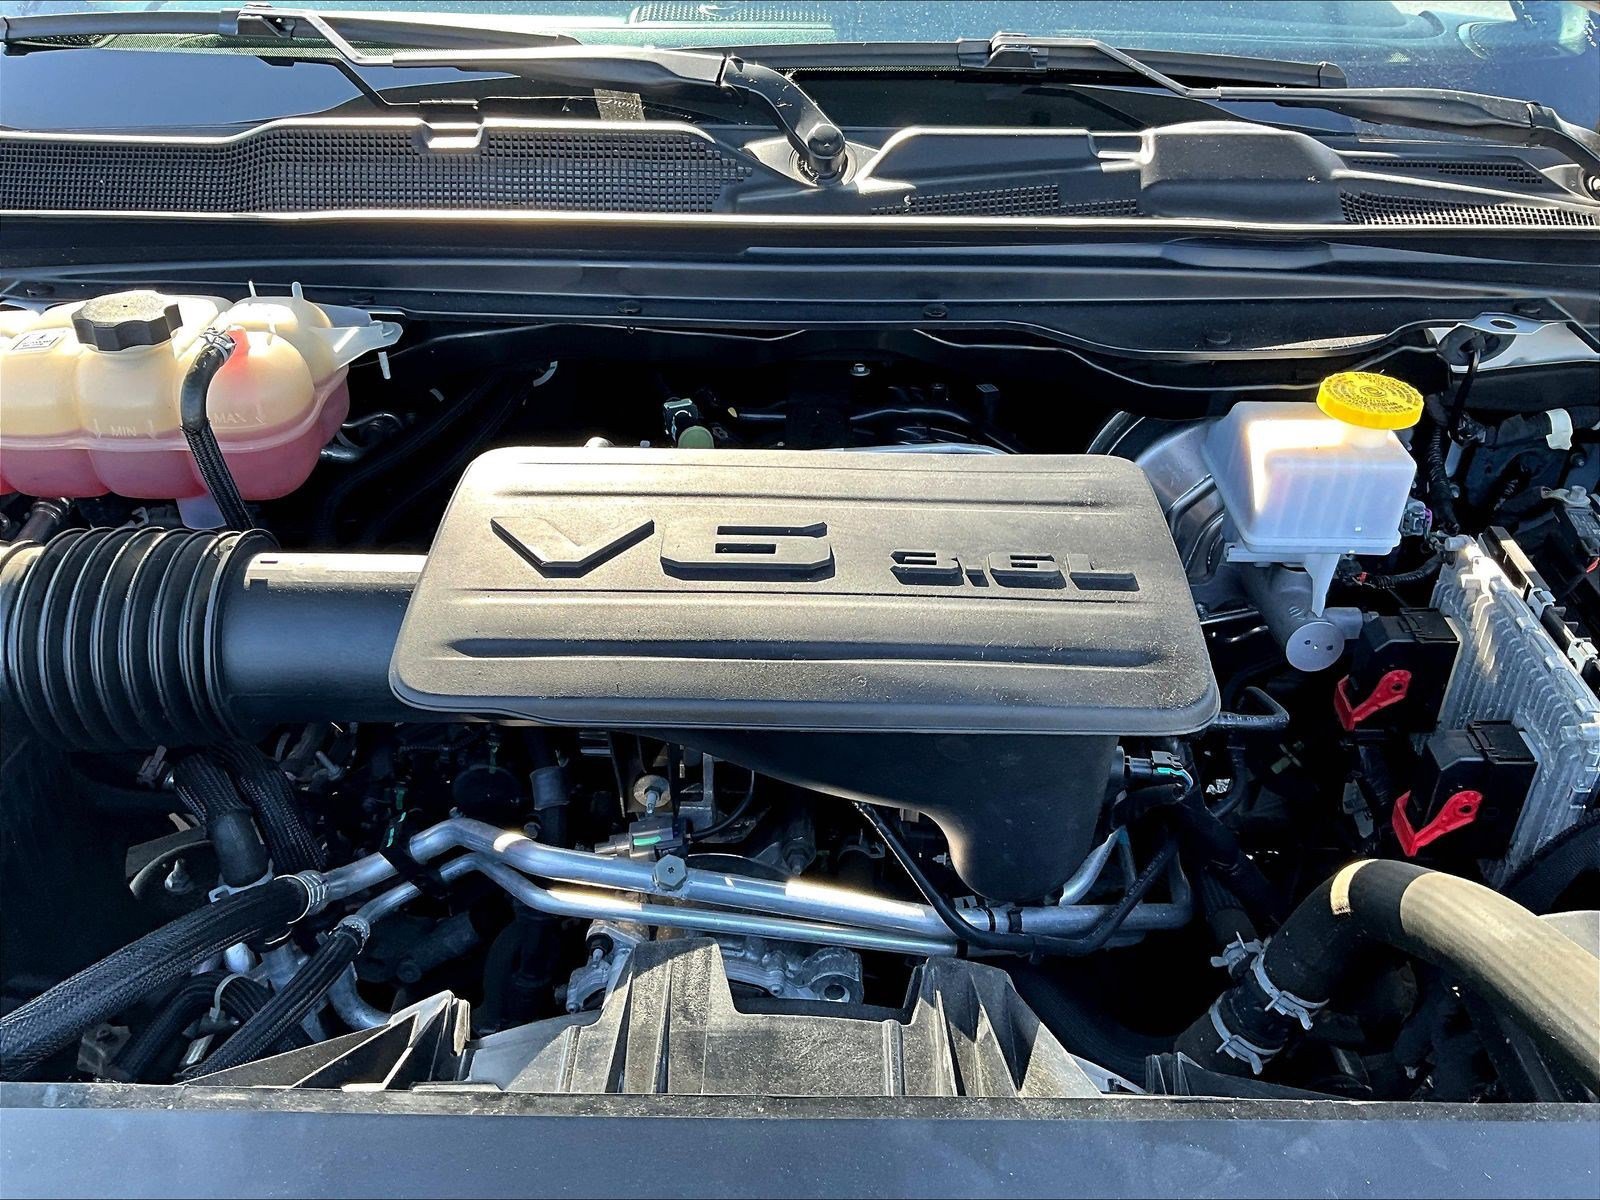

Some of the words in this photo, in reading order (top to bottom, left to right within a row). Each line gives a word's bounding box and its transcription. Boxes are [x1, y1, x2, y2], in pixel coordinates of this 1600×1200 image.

[214, 413, 247, 424] MAX
[111, 425, 137, 437] MIN
[490, 516, 836, 583] V6
[889, 550, 1141, 592] 3.6L
